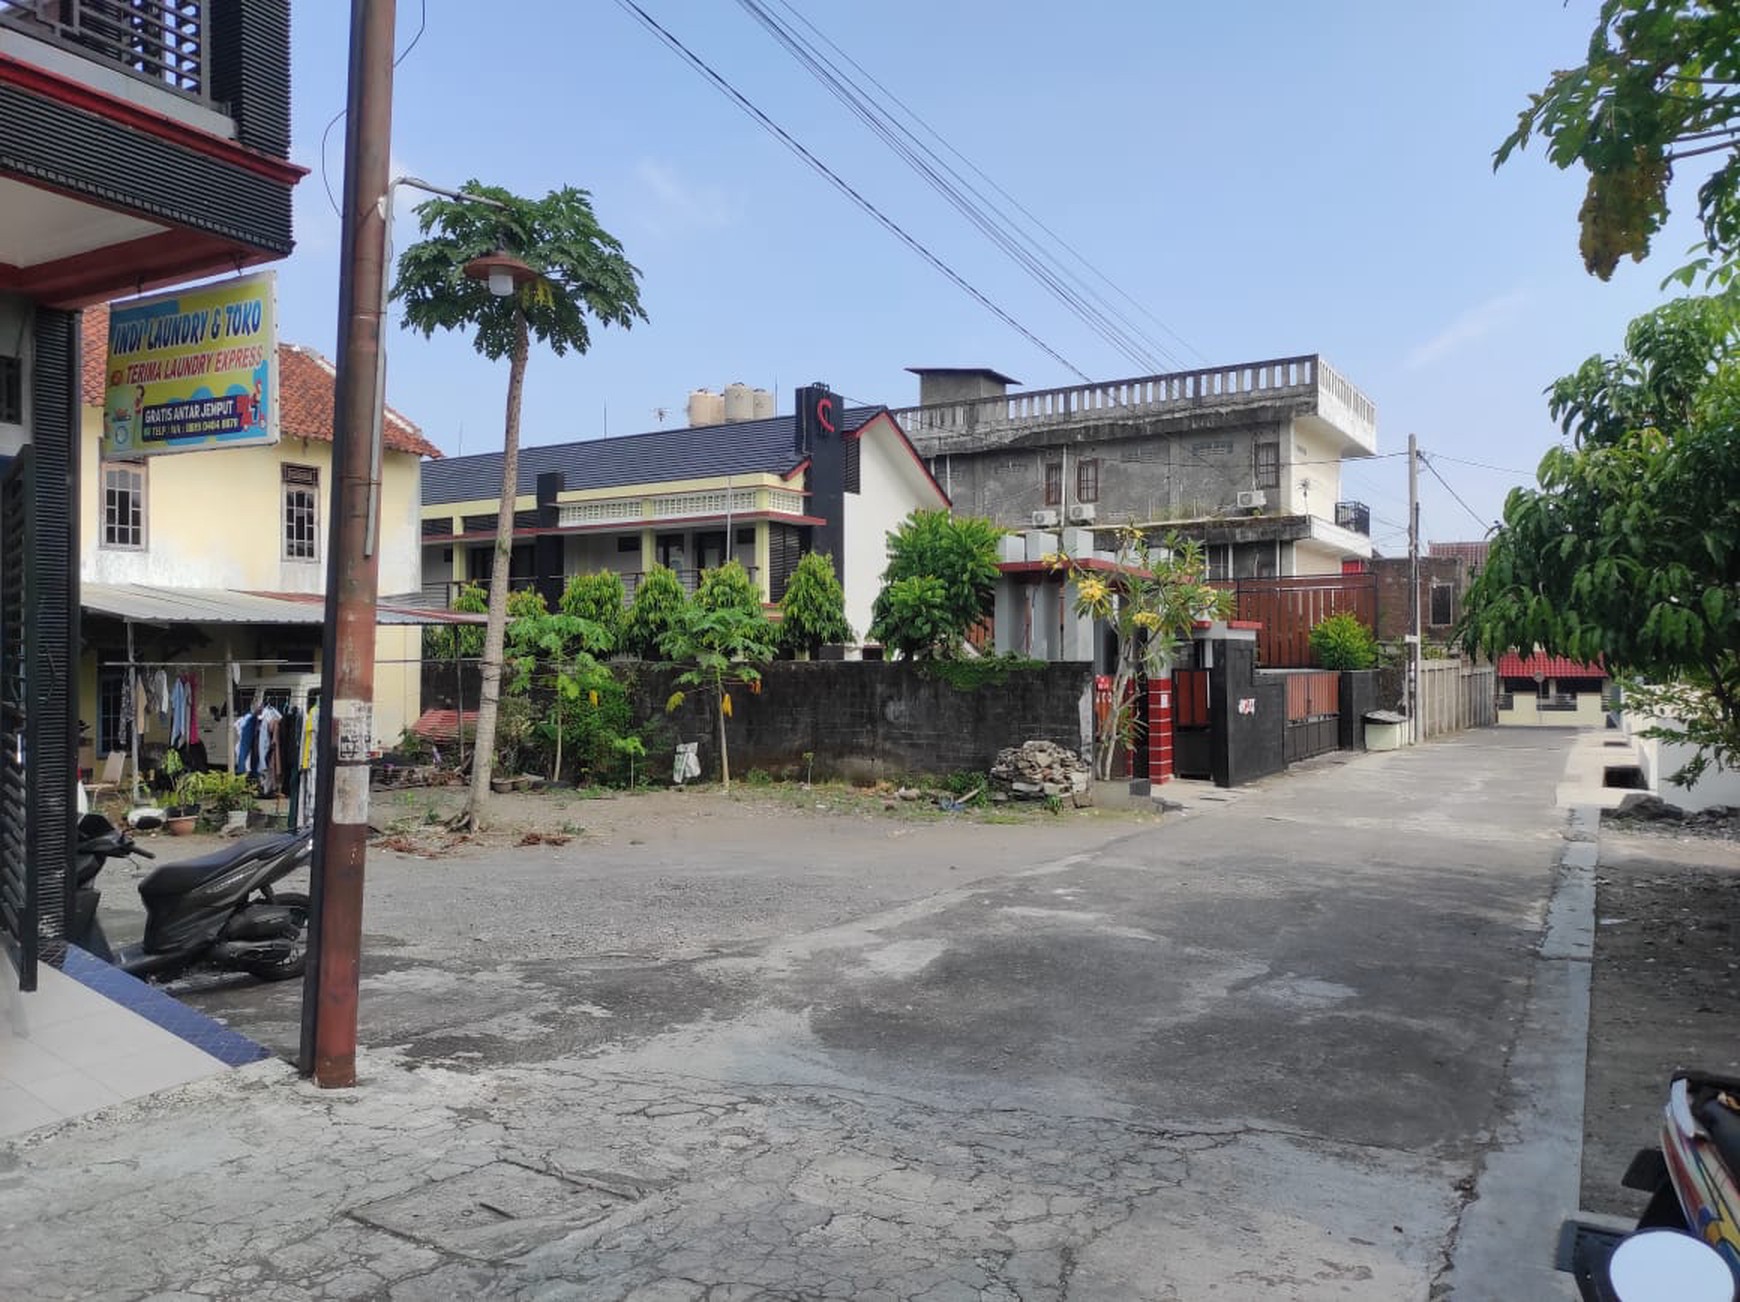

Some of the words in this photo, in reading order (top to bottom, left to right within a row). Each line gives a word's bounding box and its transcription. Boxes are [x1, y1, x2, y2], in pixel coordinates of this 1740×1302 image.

[146, 310, 209, 351] LAUNDRY
[225, 299, 262, 337] TOKO
[126, 360, 162, 385] TERIMA
[163, 351, 214, 380] LAUNDRY
[214, 344, 264, 373] EXPRESS
[144, 407, 173, 424] GRATIS
[173, 404, 201, 421] ANTAR
[201, 400, 234, 418] JEMPUT
